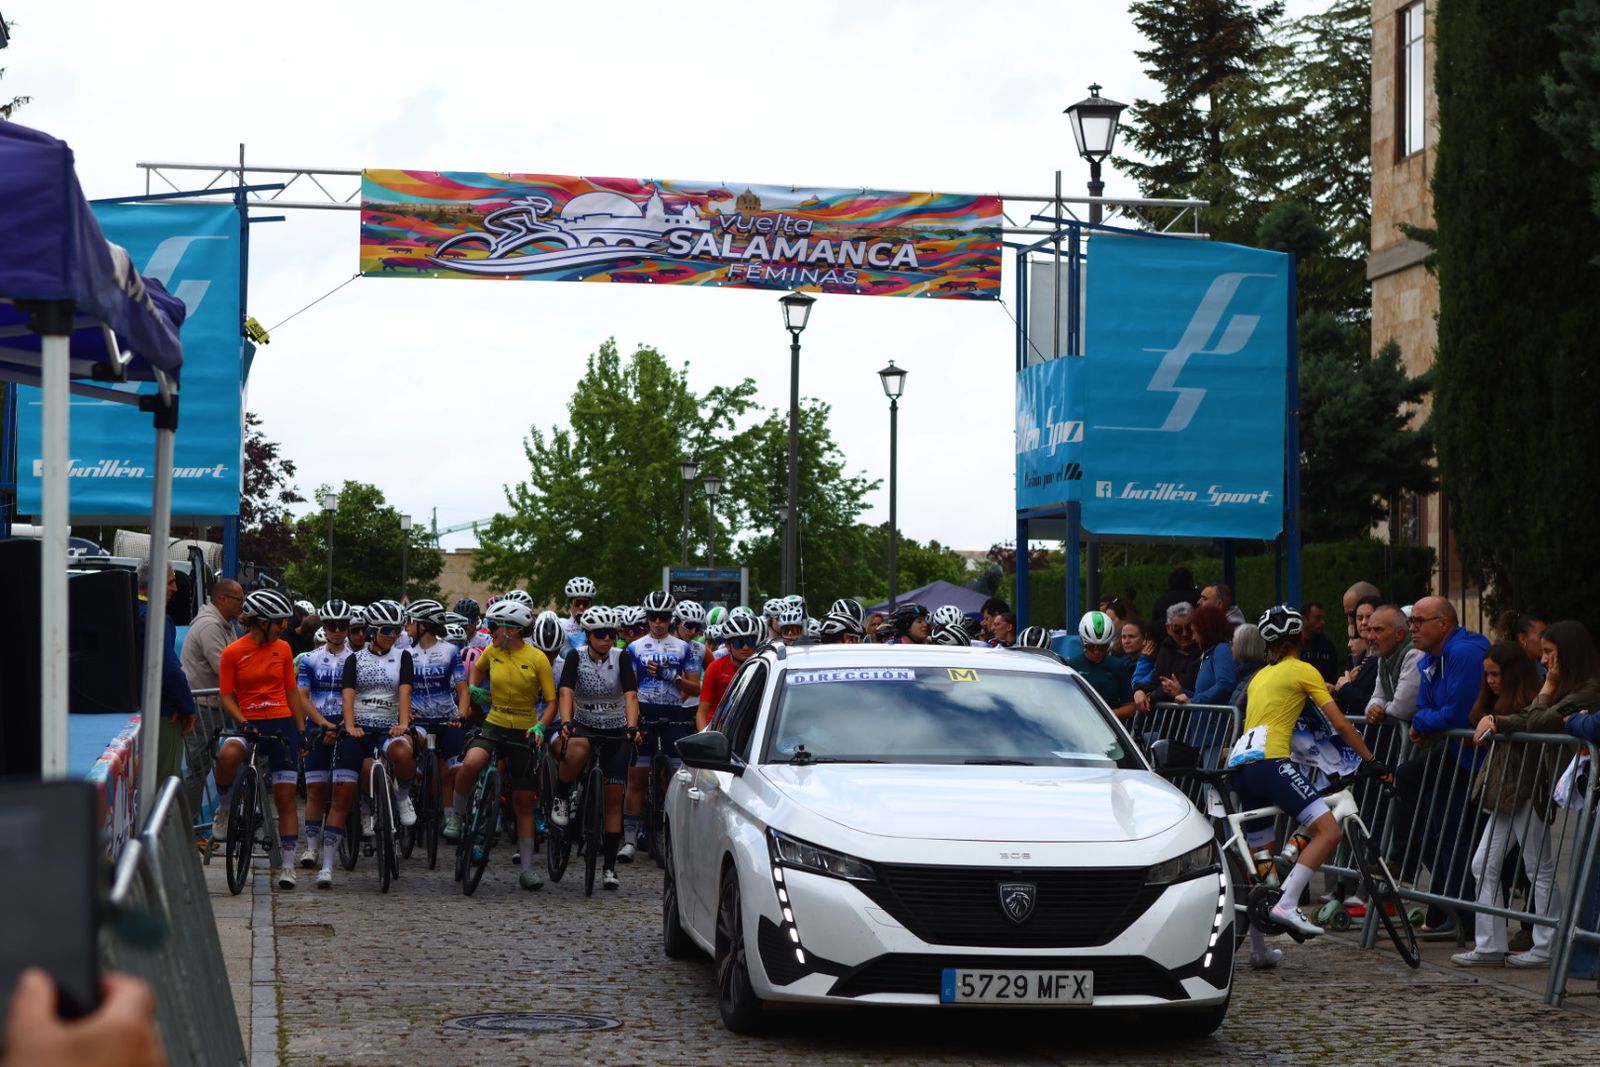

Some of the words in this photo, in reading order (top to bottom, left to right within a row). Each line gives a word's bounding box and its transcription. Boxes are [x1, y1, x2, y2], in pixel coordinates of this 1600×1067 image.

[667, 230, 919, 269] SALAMANCA
[727, 262, 859, 286] FÉMINAS
[1118, 481, 1198, 501] Guillén
[1205, 485, 1273, 507] Sport
[794, 670, 909, 684] DIRECCIÓN
[949, 669, 977, 681] M
[1245, 731, 1255, 750] 1
[961, 974, 1028, 999] 5729
[1037, 974, 1087, 999] MFX
